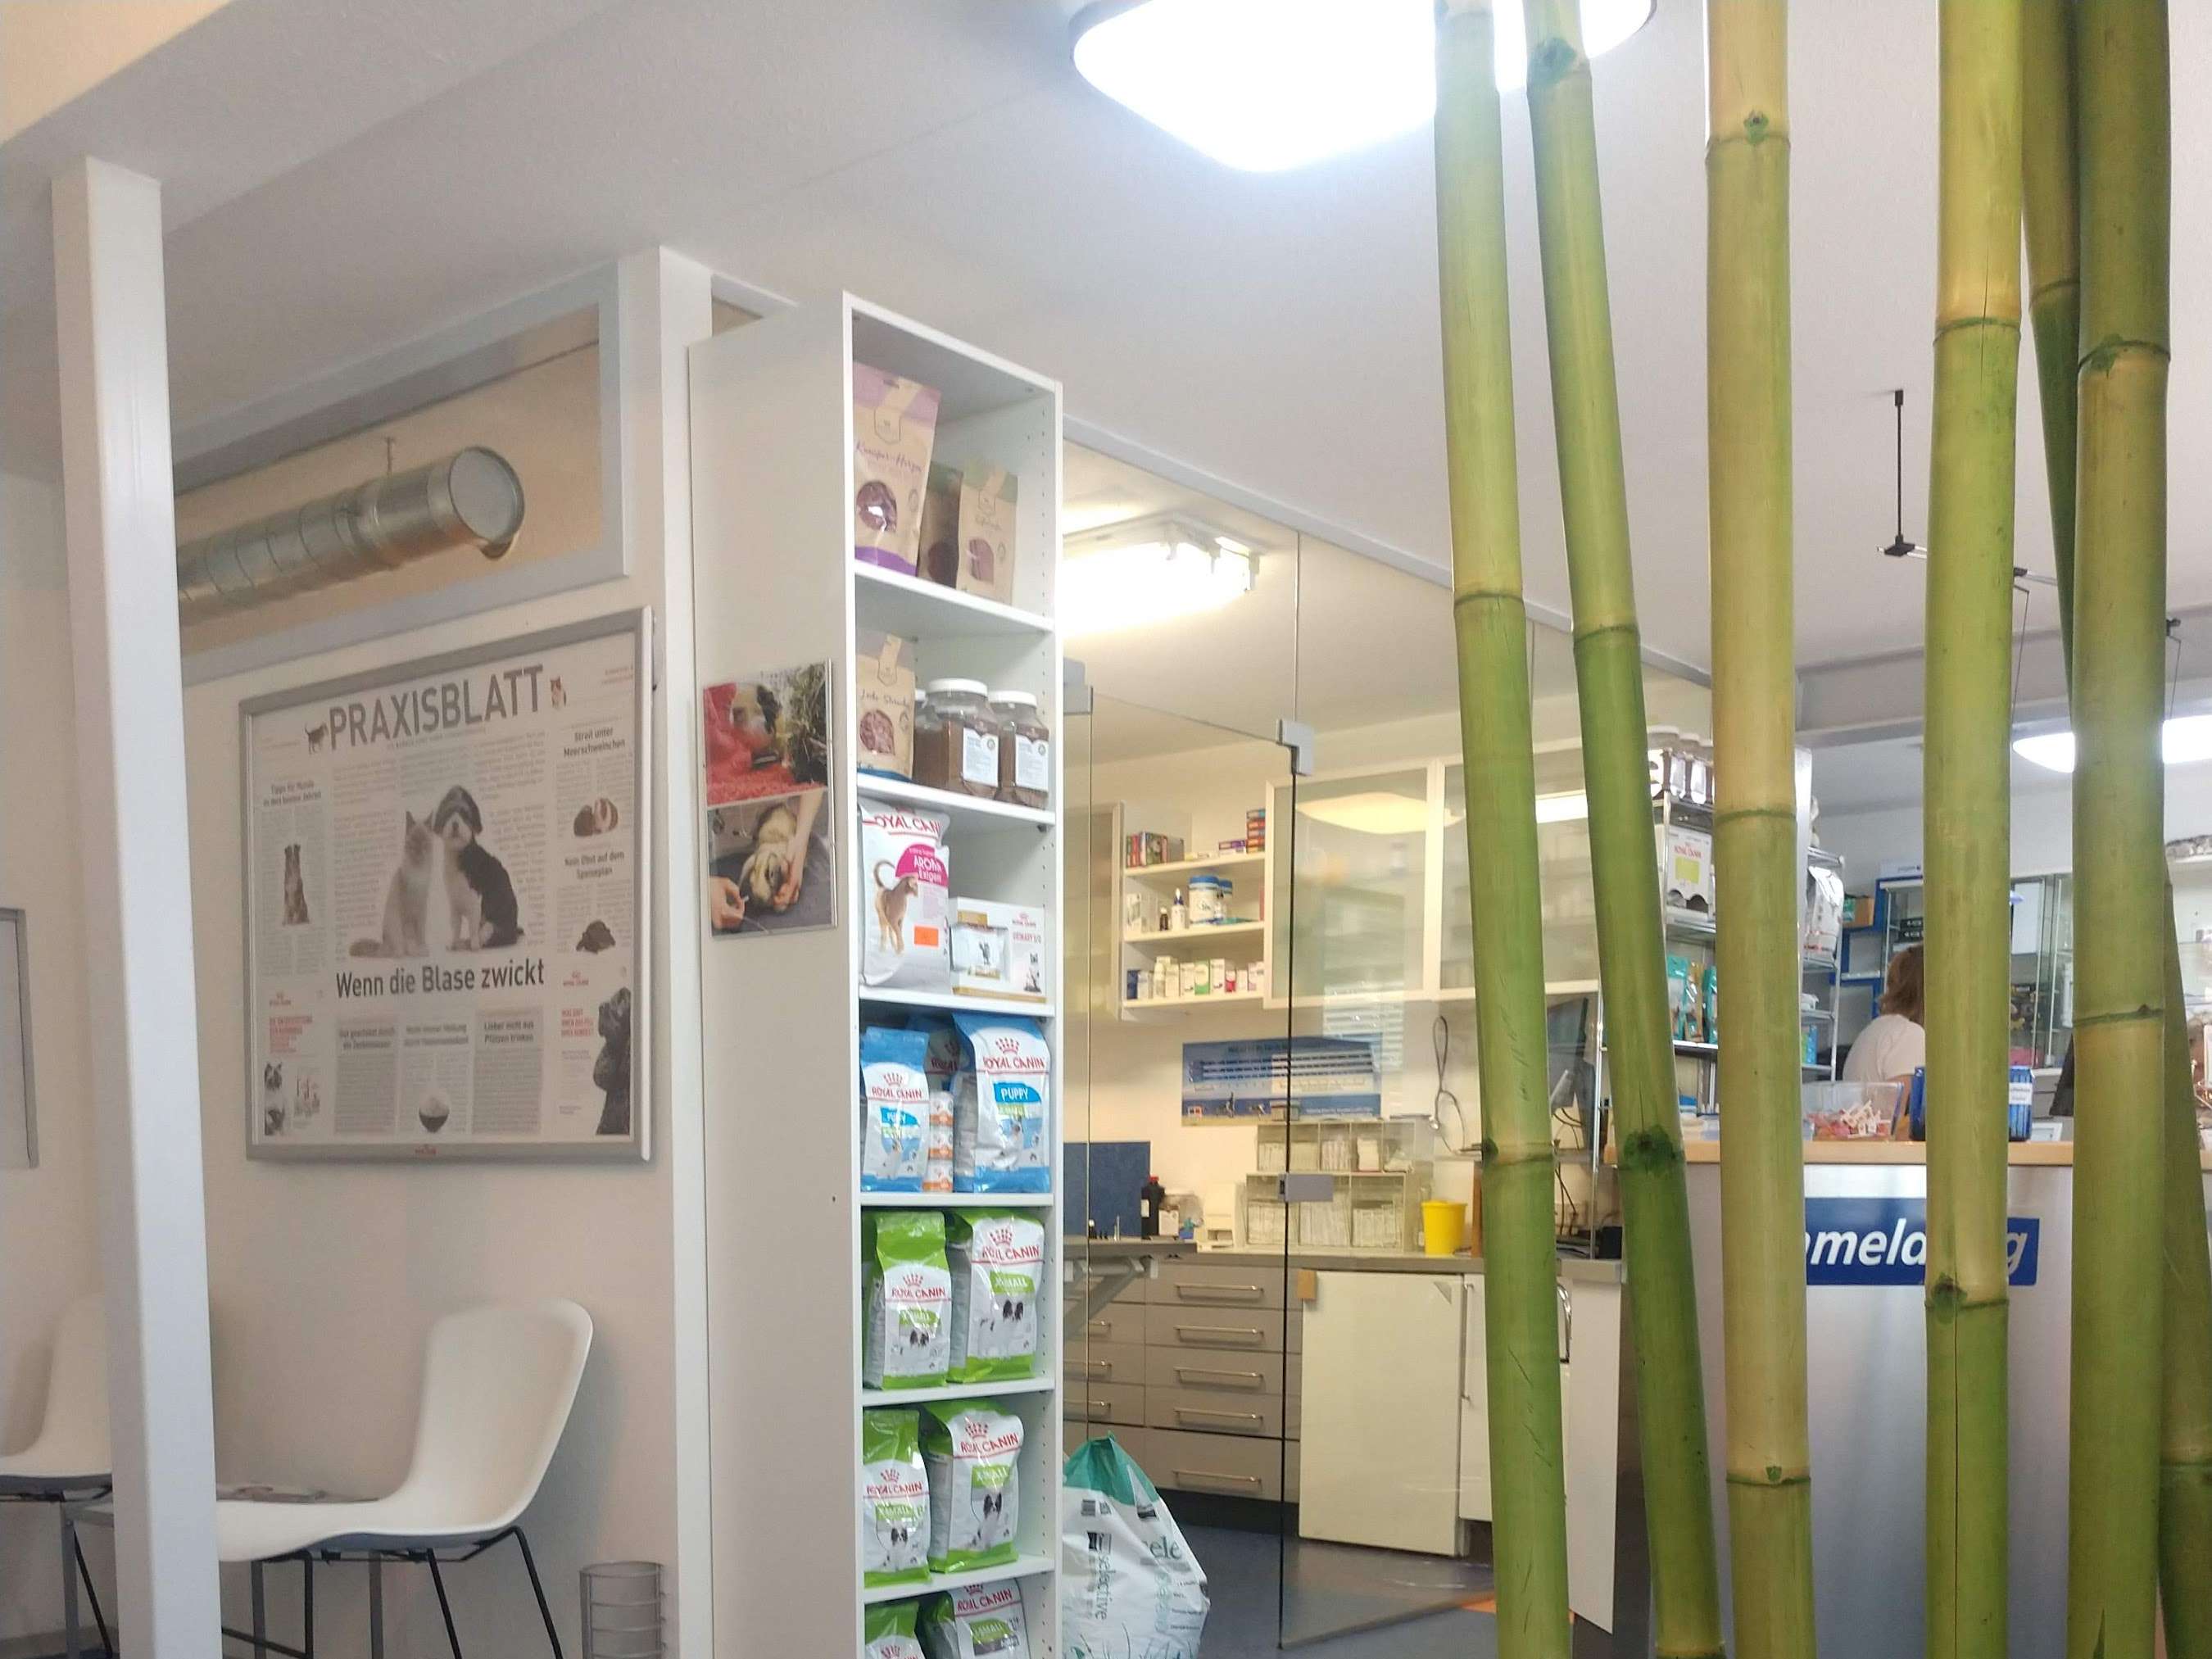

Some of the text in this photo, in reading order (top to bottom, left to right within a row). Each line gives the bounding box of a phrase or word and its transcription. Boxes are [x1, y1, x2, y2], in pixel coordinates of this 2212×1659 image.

[329, 664, 543, 750] PRAXISBLATT
[595, 728, 613, 738] unter
[874, 814, 912, 828] OYAL
[337, 959, 544, 999] Wenn die Blase zwickt
[983, 1055, 1045, 1069] ROYAL CANIN
[872, 1086, 922, 1099] ROYAL CANIN
[1001, 1087, 1029, 1102] PUPPY
[1006, 1244, 1040, 1259] CANIN
[915, 1286, 945, 1299] CANIN
[982, 1433, 1018, 1453] CANIN
[893, 1481, 922, 1493] CANIN
[1143, 1534, 1182, 1560] ele
[1095, 1556, 1116, 1620] selective
[979, 1588, 1013, 1607] CANIN
